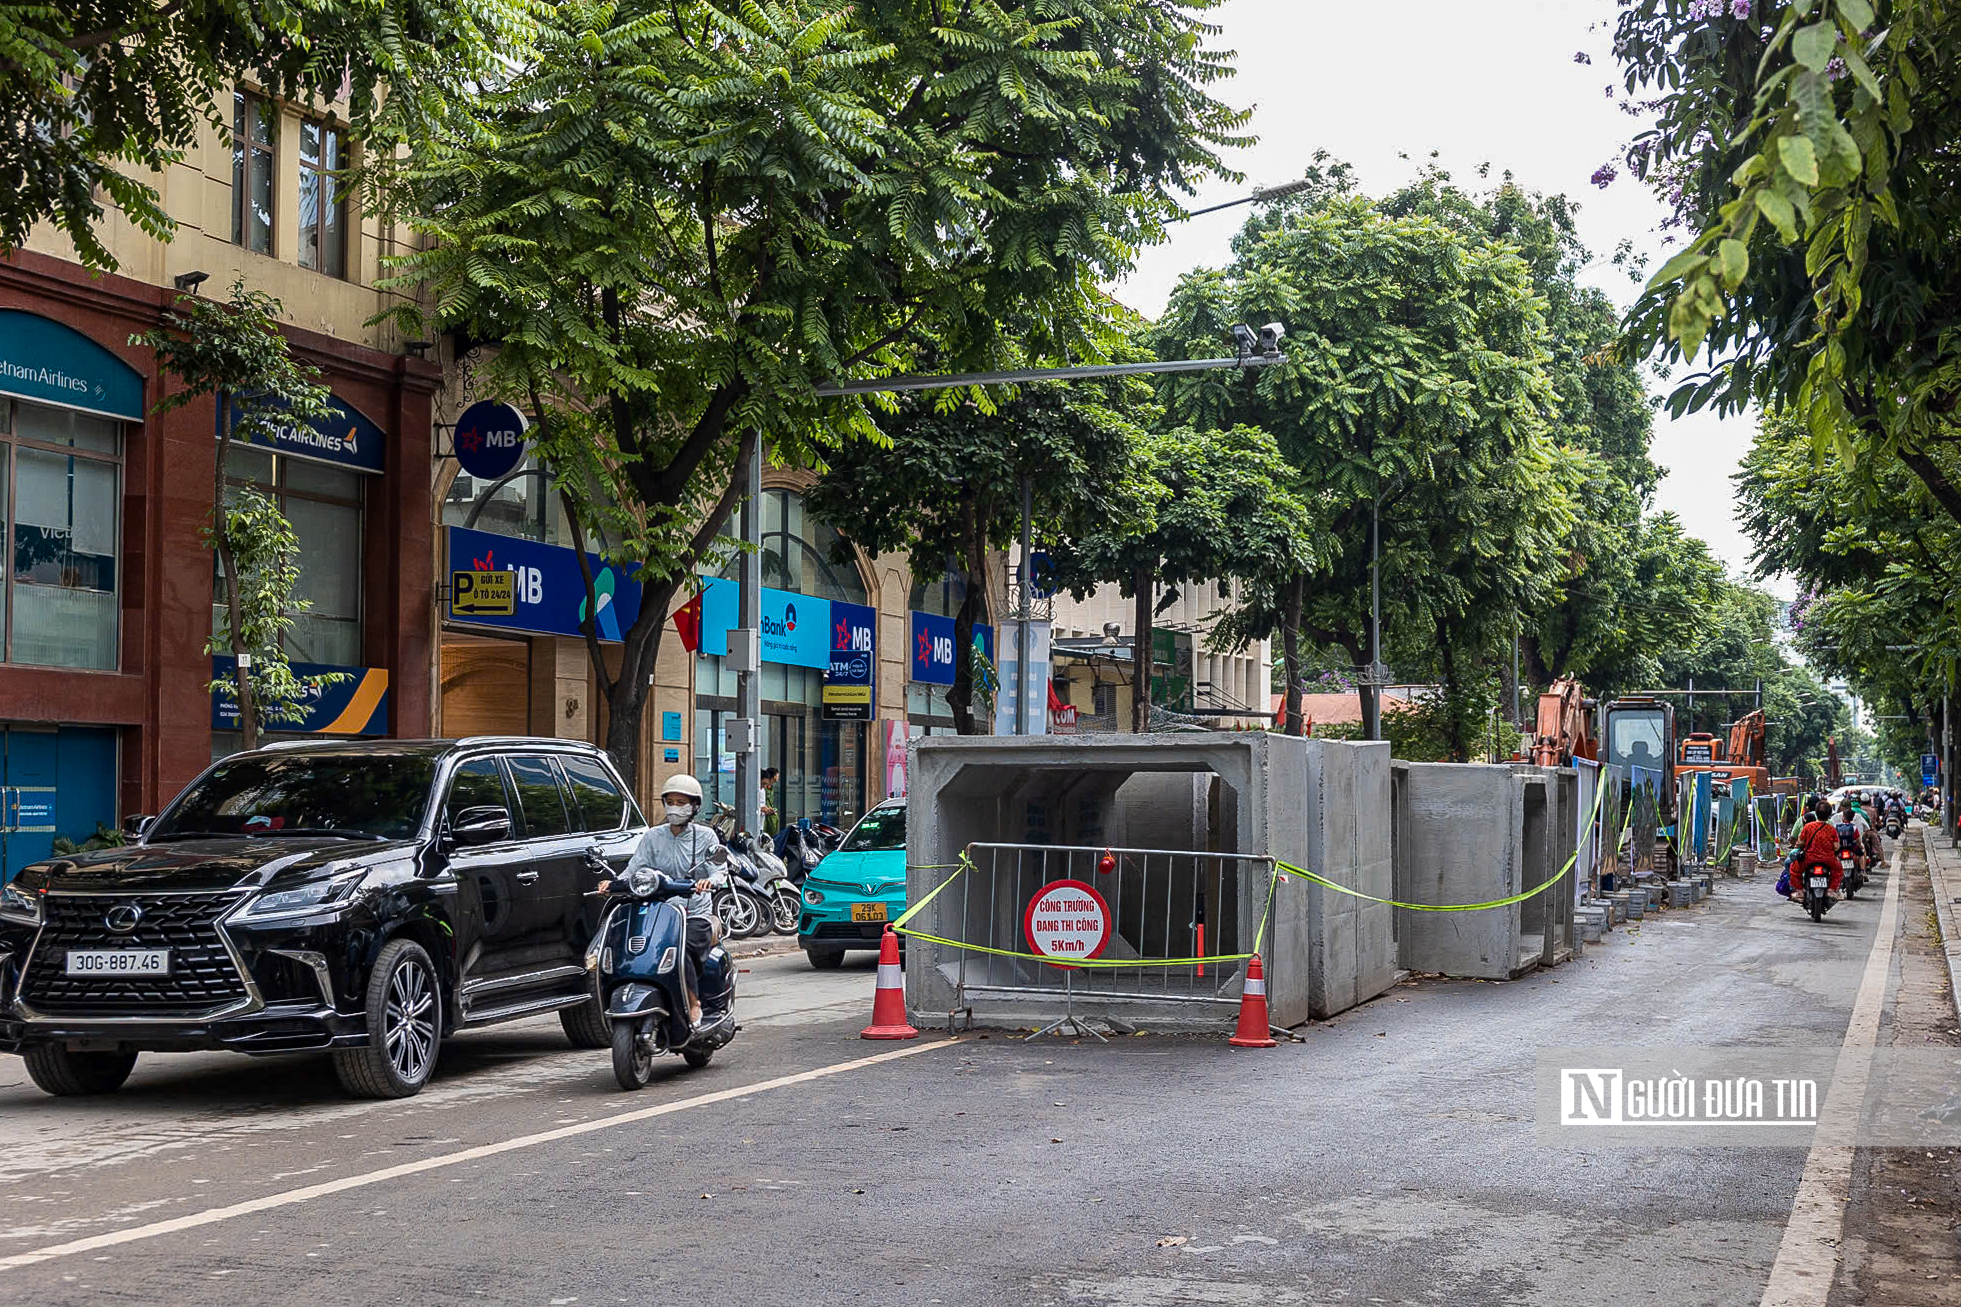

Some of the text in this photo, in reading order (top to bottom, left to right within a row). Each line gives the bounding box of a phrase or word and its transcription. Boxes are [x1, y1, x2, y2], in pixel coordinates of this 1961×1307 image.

[38, 367, 88, 393] Airlines
[288, 425, 342, 452] AIRLINES
[486, 430, 516, 448] MB
[495, 575, 505, 585] XE
[454, 573, 474, 605] P
[491, 590, 511, 600] 24/24
[852, 626, 872, 652] MB
[933, 636, 953, 665] MB
[830, 662, 849, 671] ATM
[1039, 898, 1062, 913] CÔNG
[1061, 920, 1074, 932] THI
[1076, 917, 1099, 932] CÔNG
[1051, 939, 1085, 952] 5Km/h
[76, 954, 160, 970] 30G-887.46
